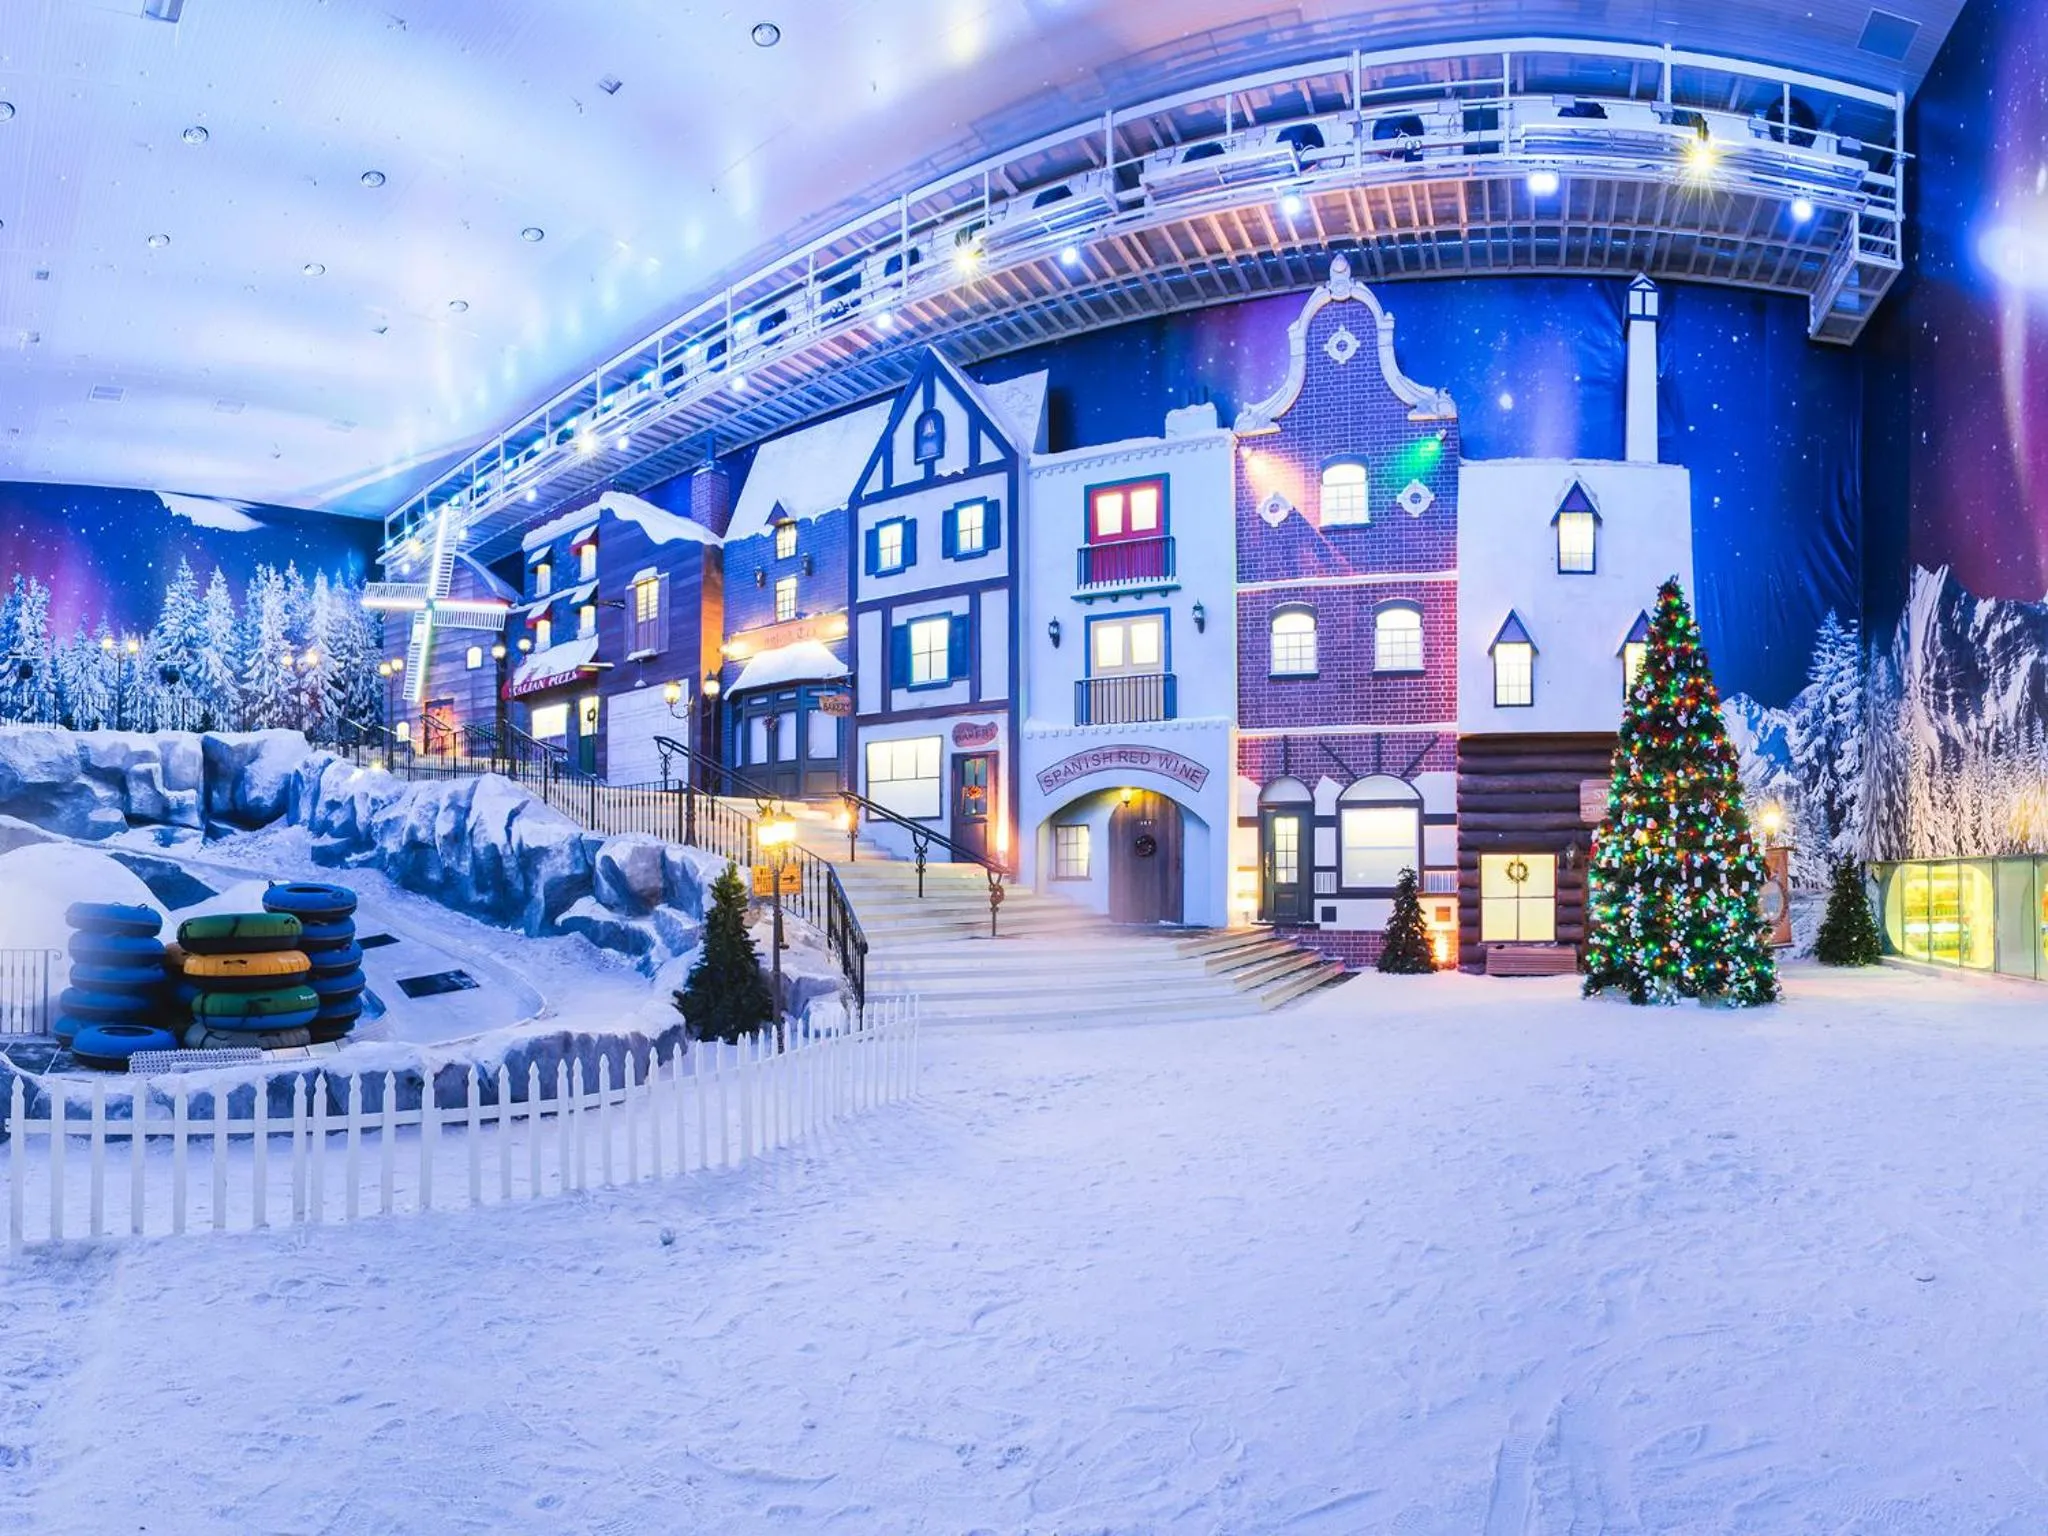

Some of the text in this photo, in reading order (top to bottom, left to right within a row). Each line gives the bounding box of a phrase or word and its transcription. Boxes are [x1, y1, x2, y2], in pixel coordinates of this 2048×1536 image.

[548, 670, 577, 687] PIZZA
[823, 702, 849, 712] BAKERY
[1043, 750, 1201, 788] SPANISH RED WINE
